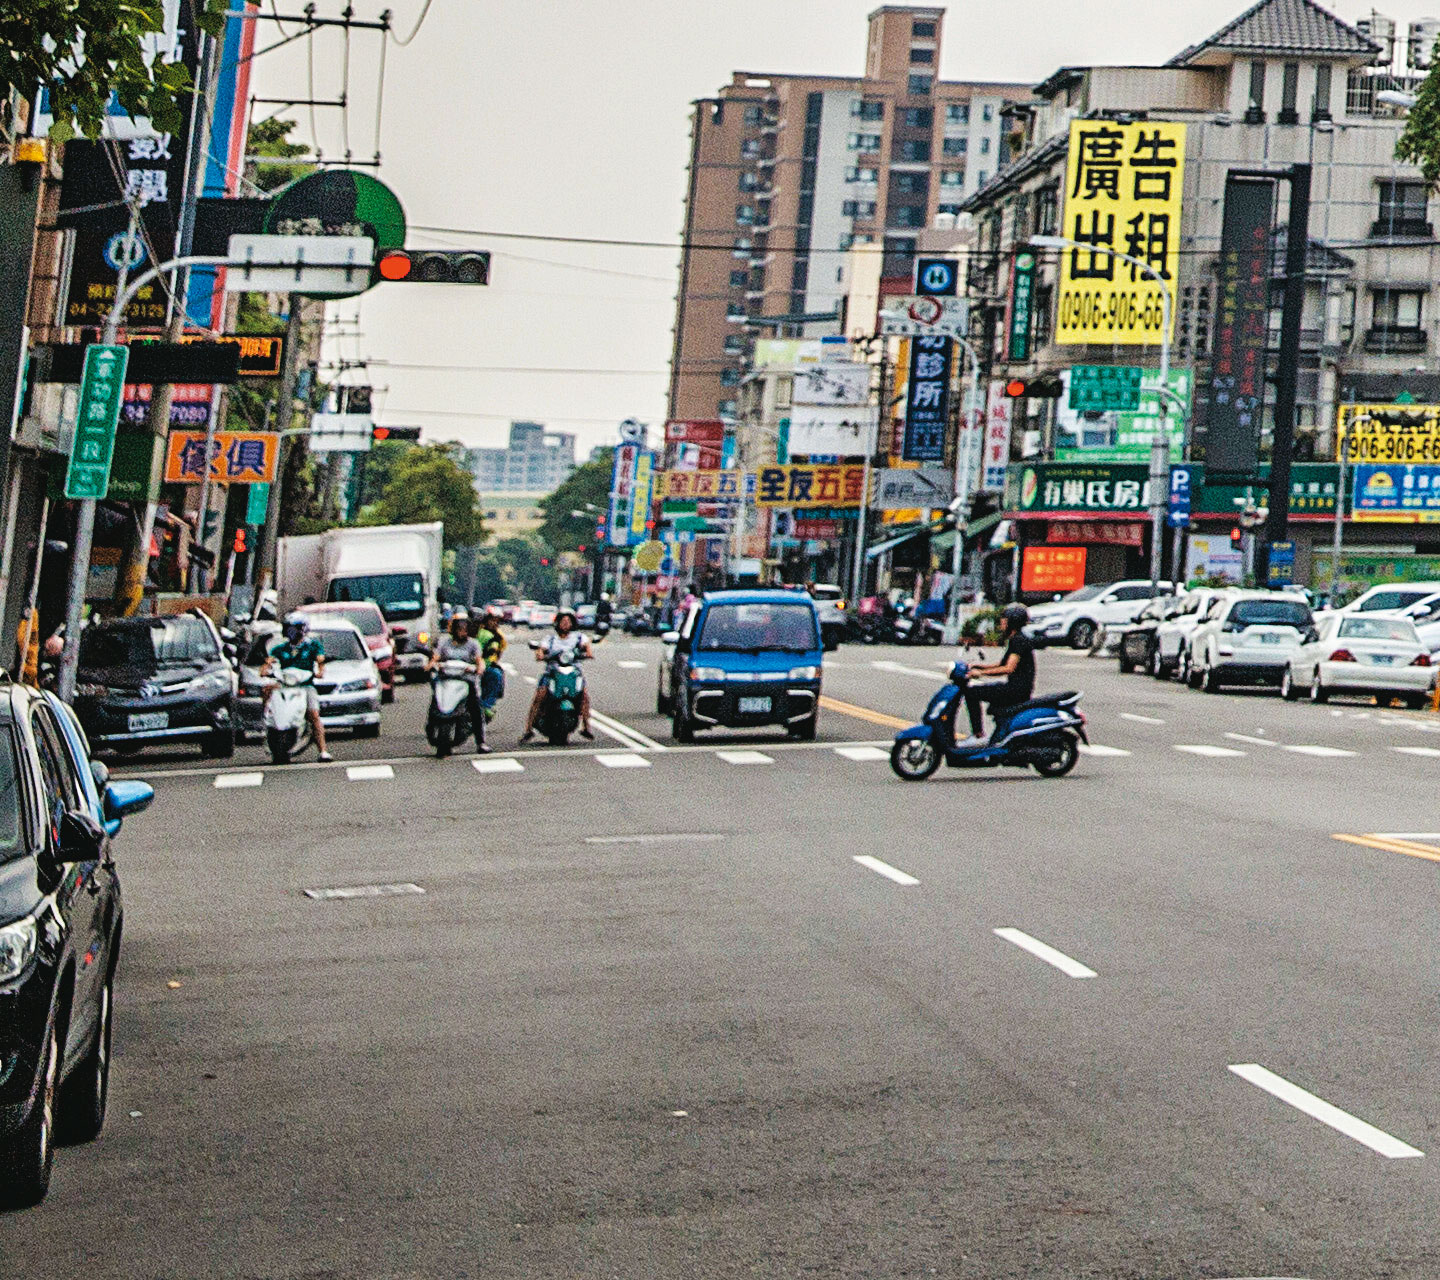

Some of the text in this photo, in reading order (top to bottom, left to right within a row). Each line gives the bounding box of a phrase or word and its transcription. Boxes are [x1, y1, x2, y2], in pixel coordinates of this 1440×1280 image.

[1072, 126, 1177, 201] 廣告
[1069, 210, 1172, 282] 出租
[179, 438, 267, 477] 傢俱
[760, 467, 864, 503] 全友五金
